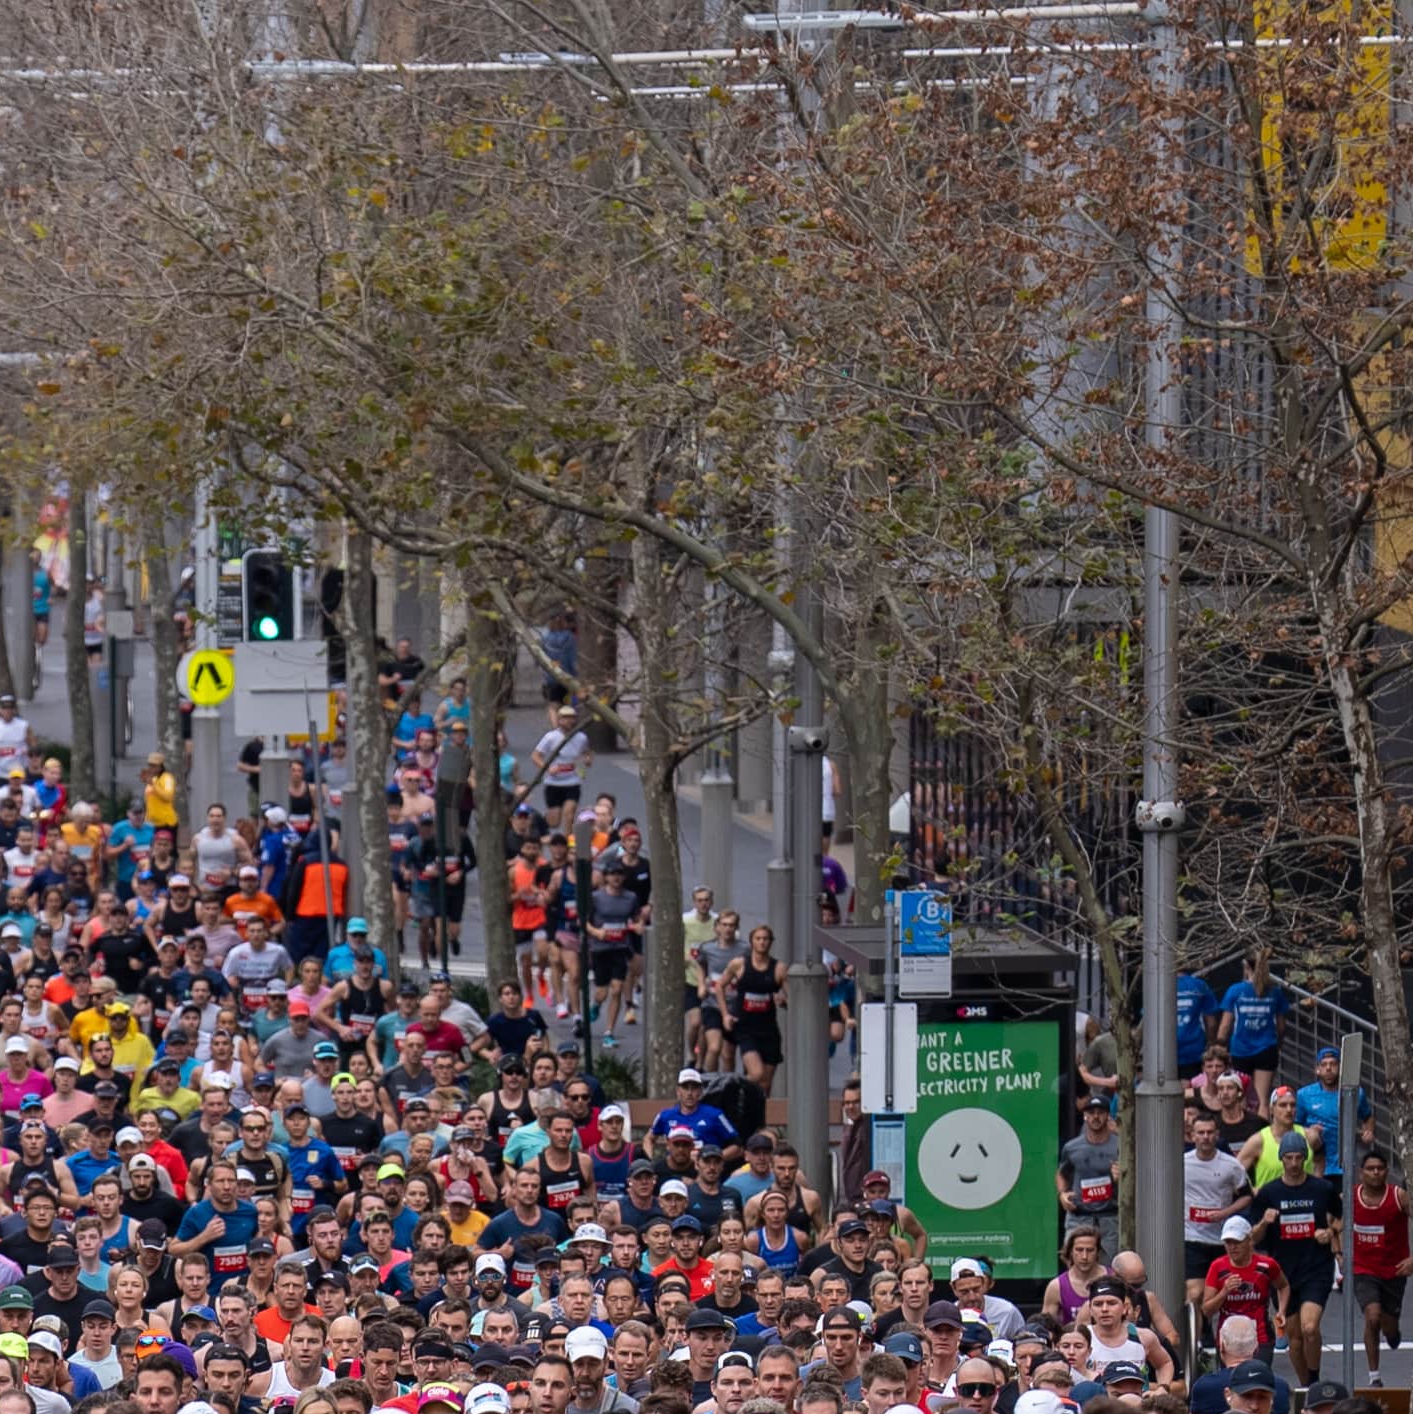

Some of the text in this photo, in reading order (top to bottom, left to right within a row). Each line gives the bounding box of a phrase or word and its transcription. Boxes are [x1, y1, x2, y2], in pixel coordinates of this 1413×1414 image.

[954, 1032, 963, 1046] A
[926, 1048, 1014, 1073] GREENER
[917, 1071, 1041, 1097] ECTRICITY PLAN?
[1288, 1200, 1314, 1208] SCIDEV
[1285, 1224, 1310, 1234] 6826
